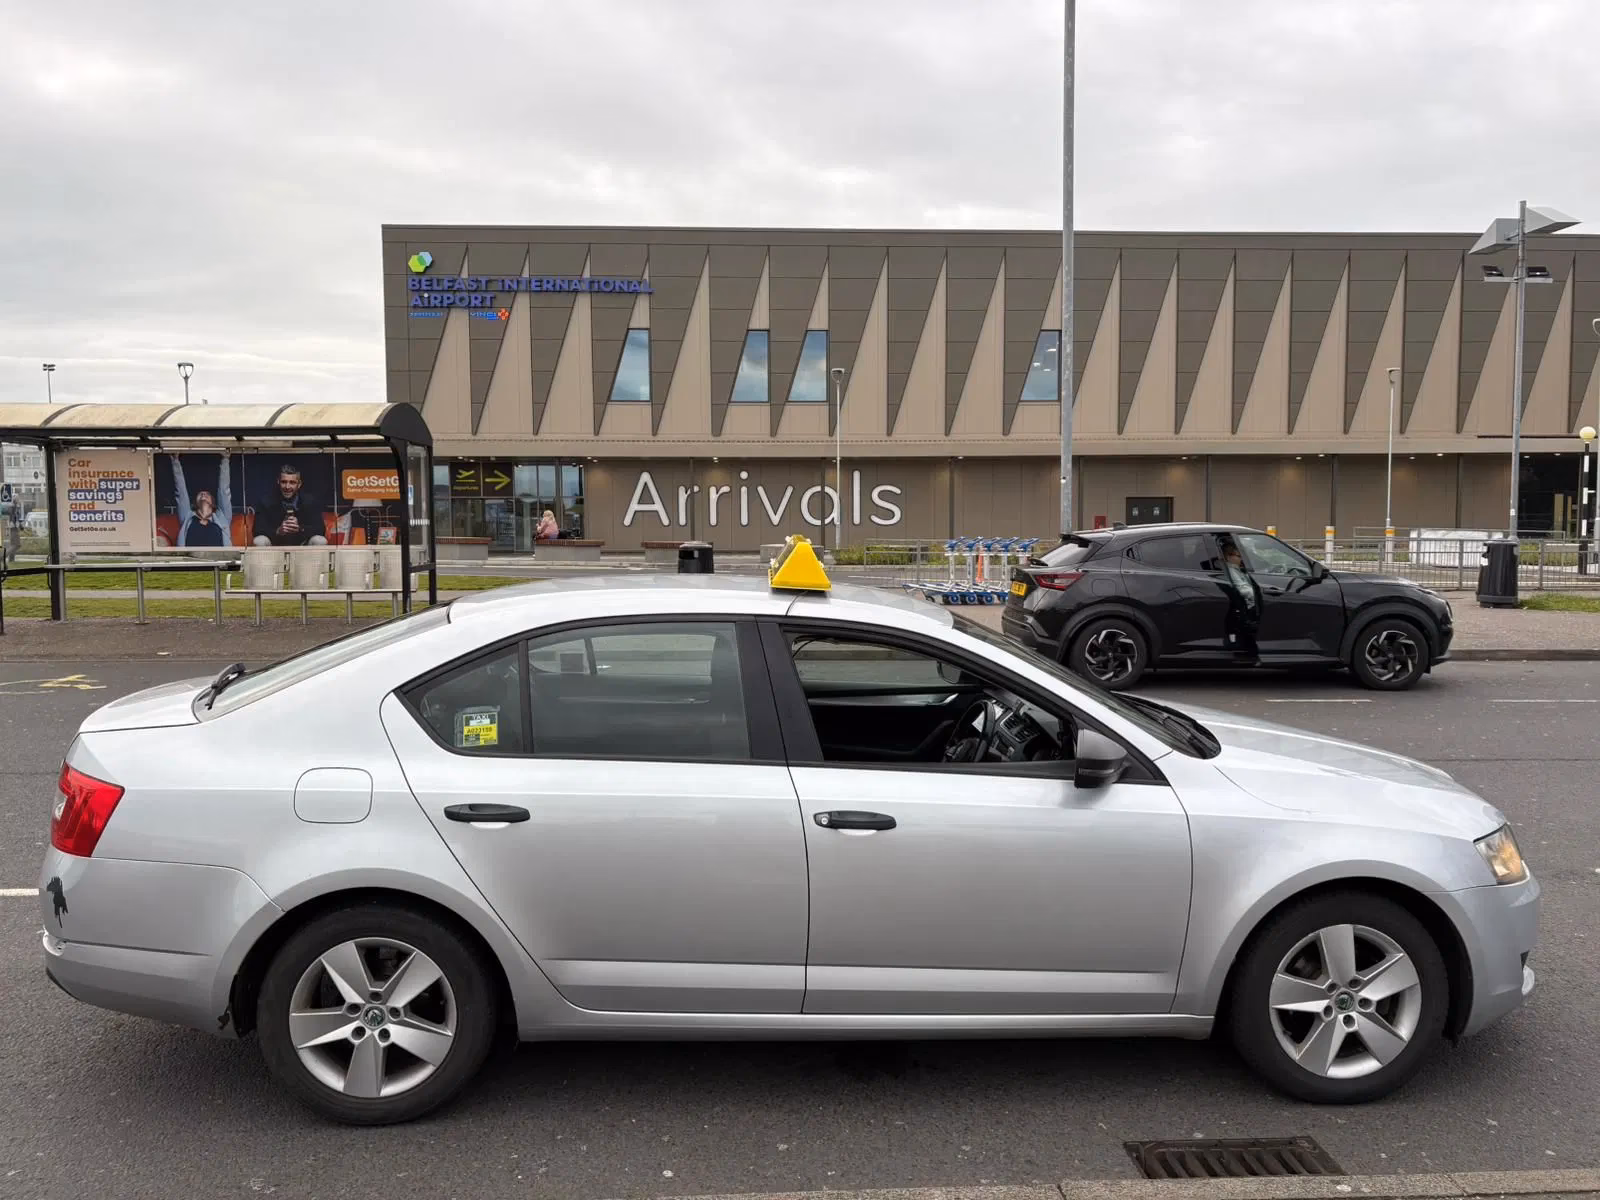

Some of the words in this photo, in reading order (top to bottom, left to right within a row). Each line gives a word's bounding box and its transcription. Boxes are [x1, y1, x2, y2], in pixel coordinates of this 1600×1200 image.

[408, 276, 489, 291] BELFAST
[68, 458, 91, 468] Car
[68, 468, 135, 479] insurance
[68, 479, 97, 489] with
[99, 480, 139, 492] super
[347, 475, 400, 487] GetSetG
[69, 489, 123, 503] savings
[623, 470, 903, 527] Arrivals
[70, 501, 96, 510] and
[70, 510, 124, 521] benefits
